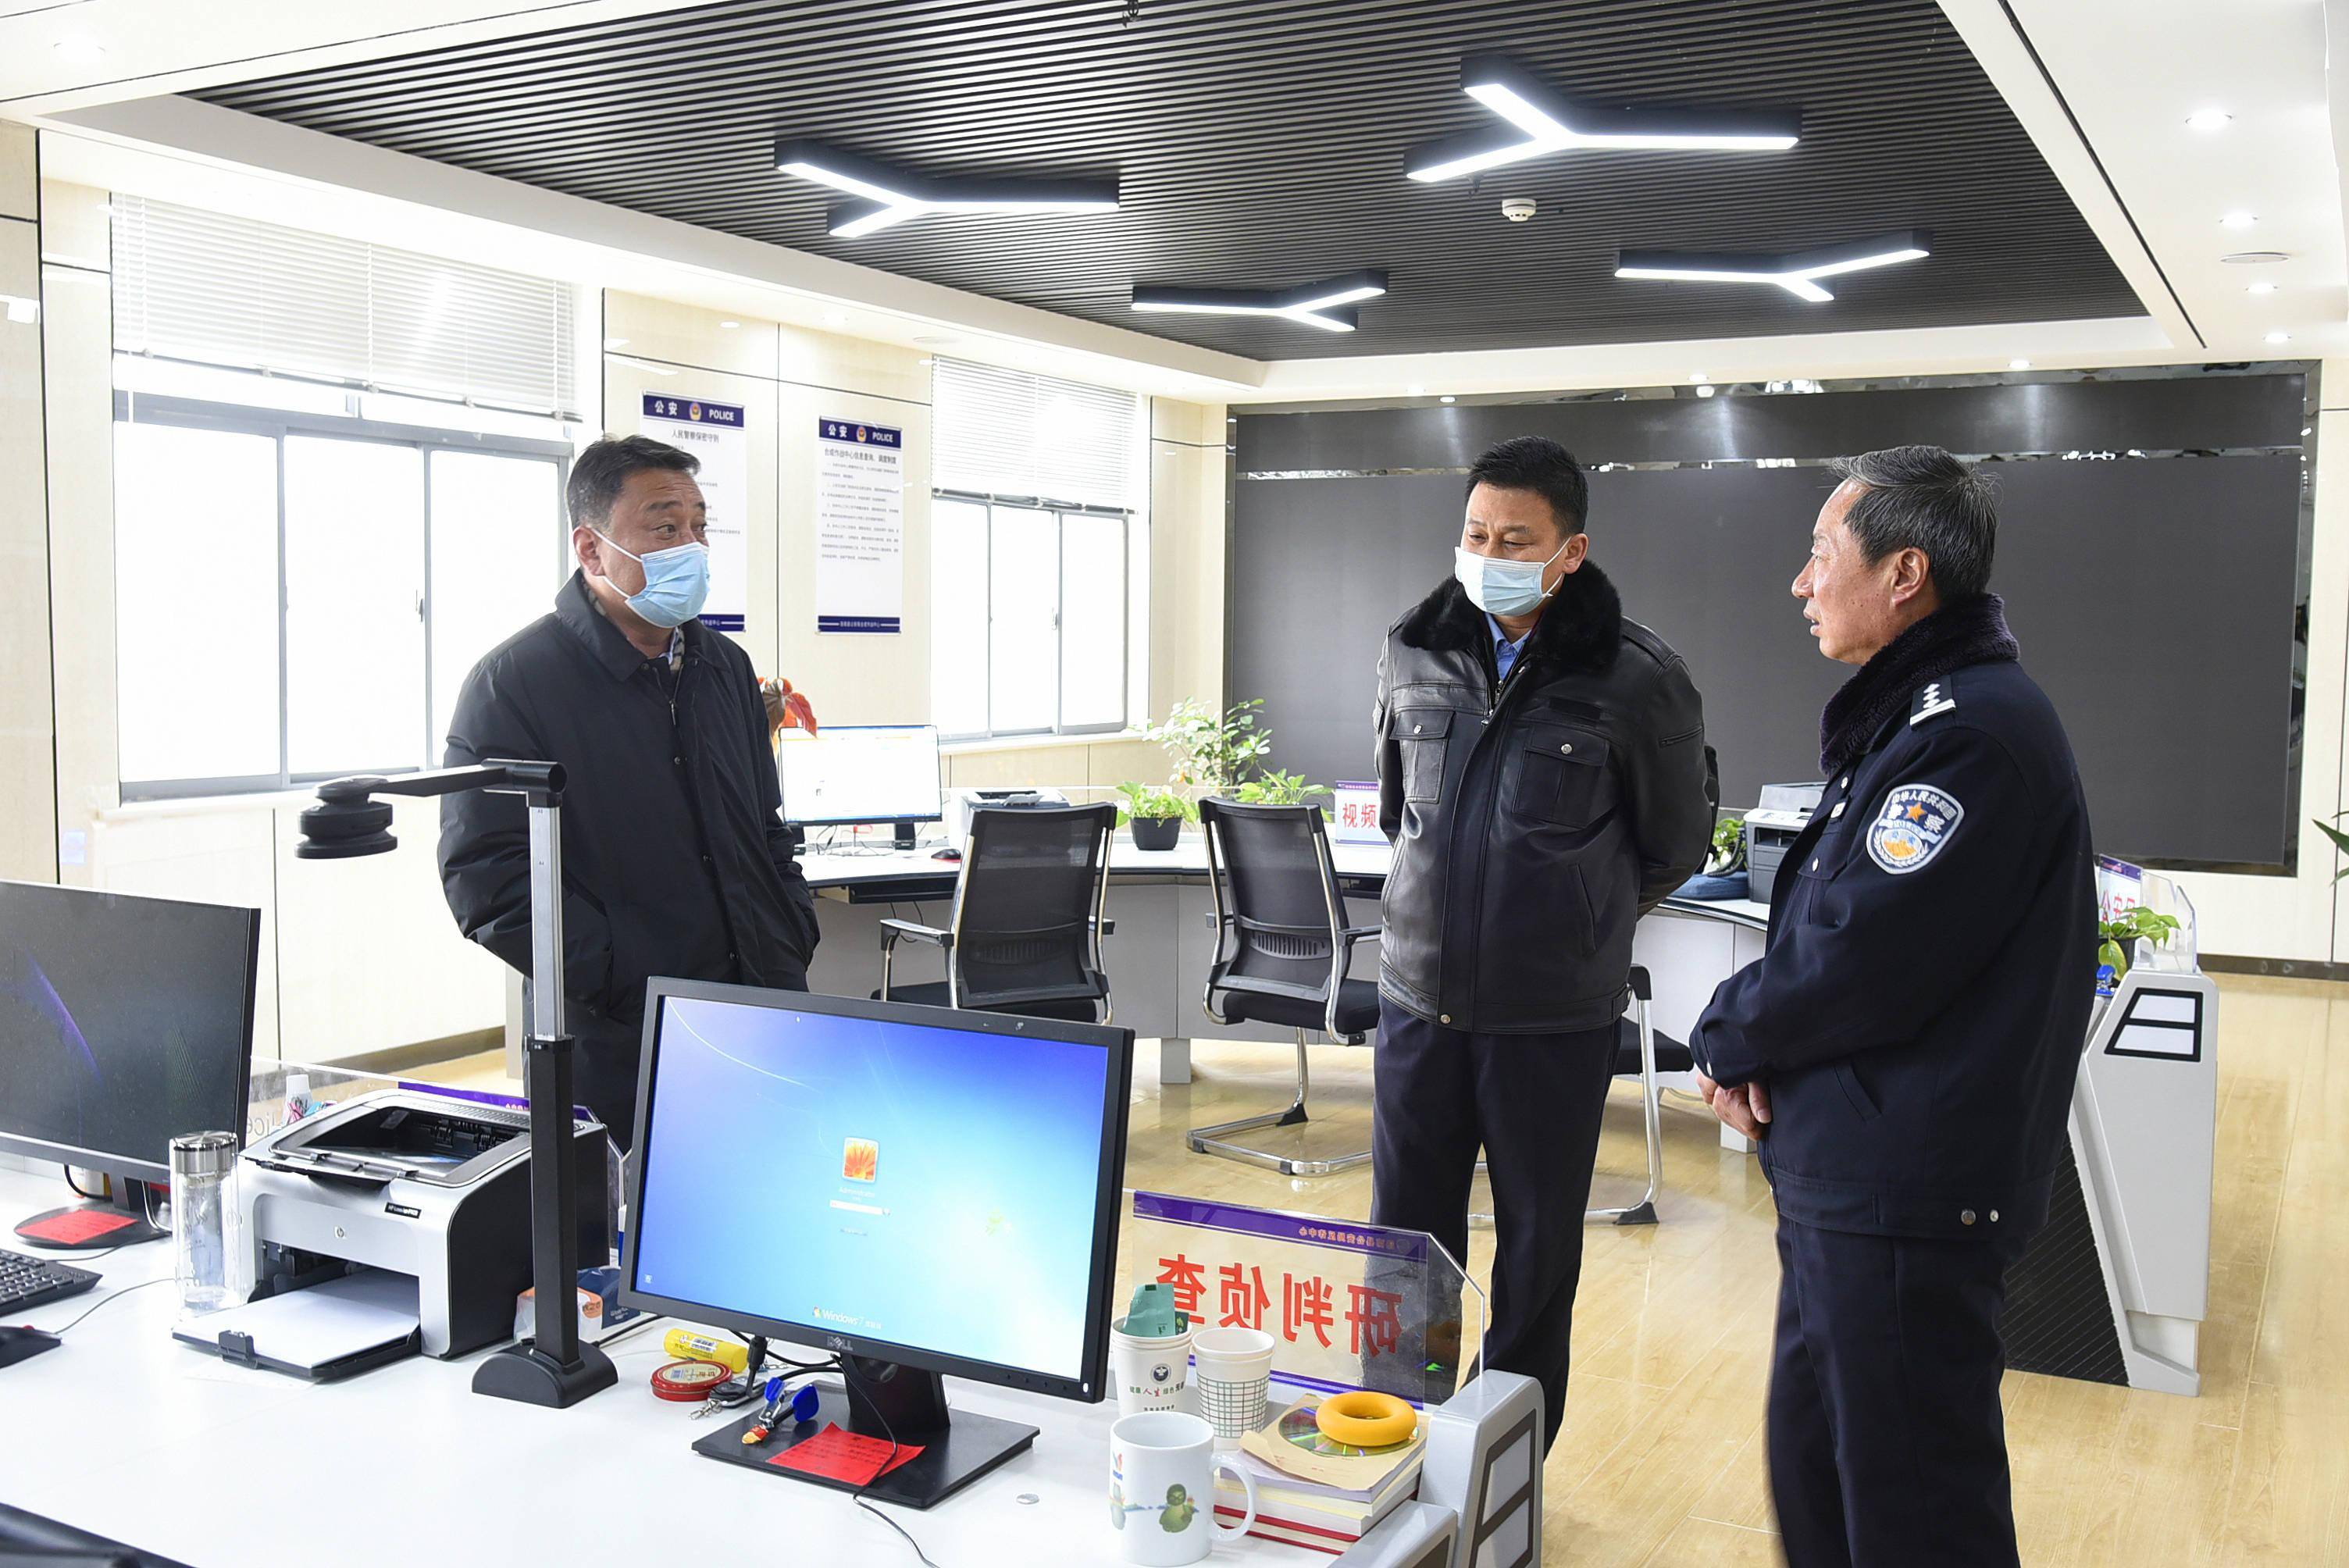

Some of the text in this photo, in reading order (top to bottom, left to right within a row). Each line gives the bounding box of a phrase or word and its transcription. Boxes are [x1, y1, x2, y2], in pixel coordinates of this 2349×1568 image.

[654, 400, 678, 415] 公安
[709, 408, 735, 422] POLICE
[829, 424, 847, 438] 公安
[872, 431, 893, 443] POLICE
[1342, 803, 1377, 829] 视频
[823, 1310, 859, 1325] Windows
[827, 1336, 854, 1351] DELL
